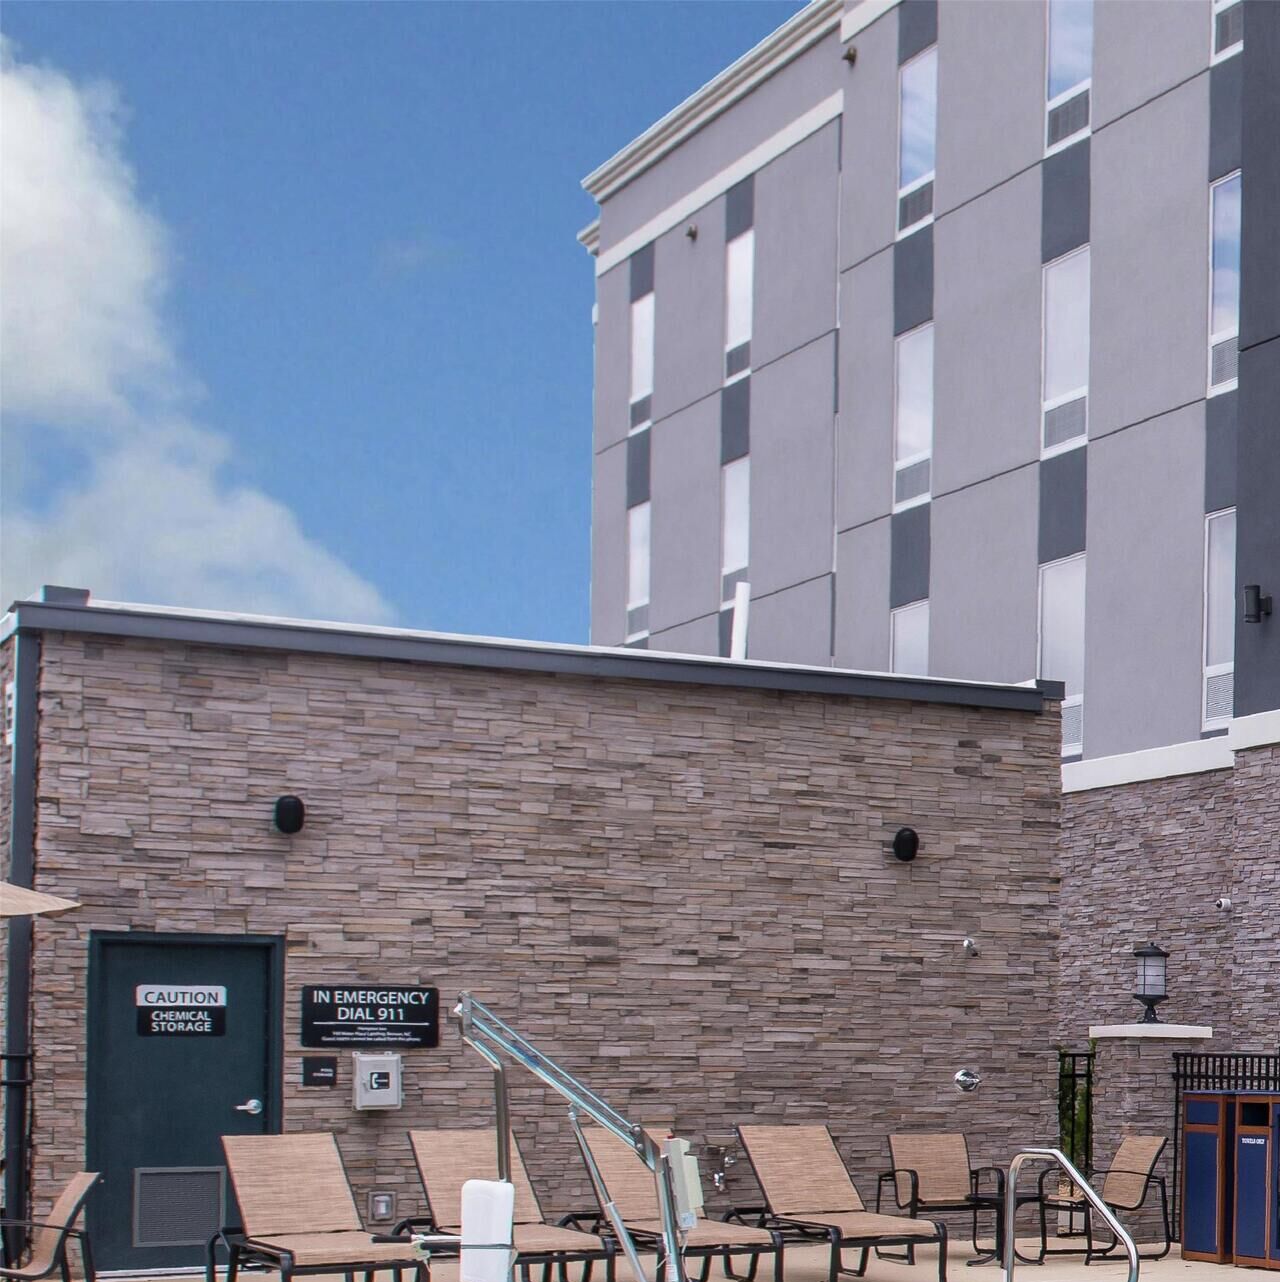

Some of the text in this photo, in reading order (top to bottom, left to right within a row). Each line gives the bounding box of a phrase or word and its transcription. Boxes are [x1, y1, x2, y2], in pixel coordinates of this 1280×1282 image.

[144, 991, 219, 1004] CAUTION
[313, 990, 429, 1005] IN EMERGENCY
[151, 1011, 212, 1021] CHEMICAL
[338, 1007, 404, 1020] DIAL 911
[151, 1022, 212, 1032] STORAGE
